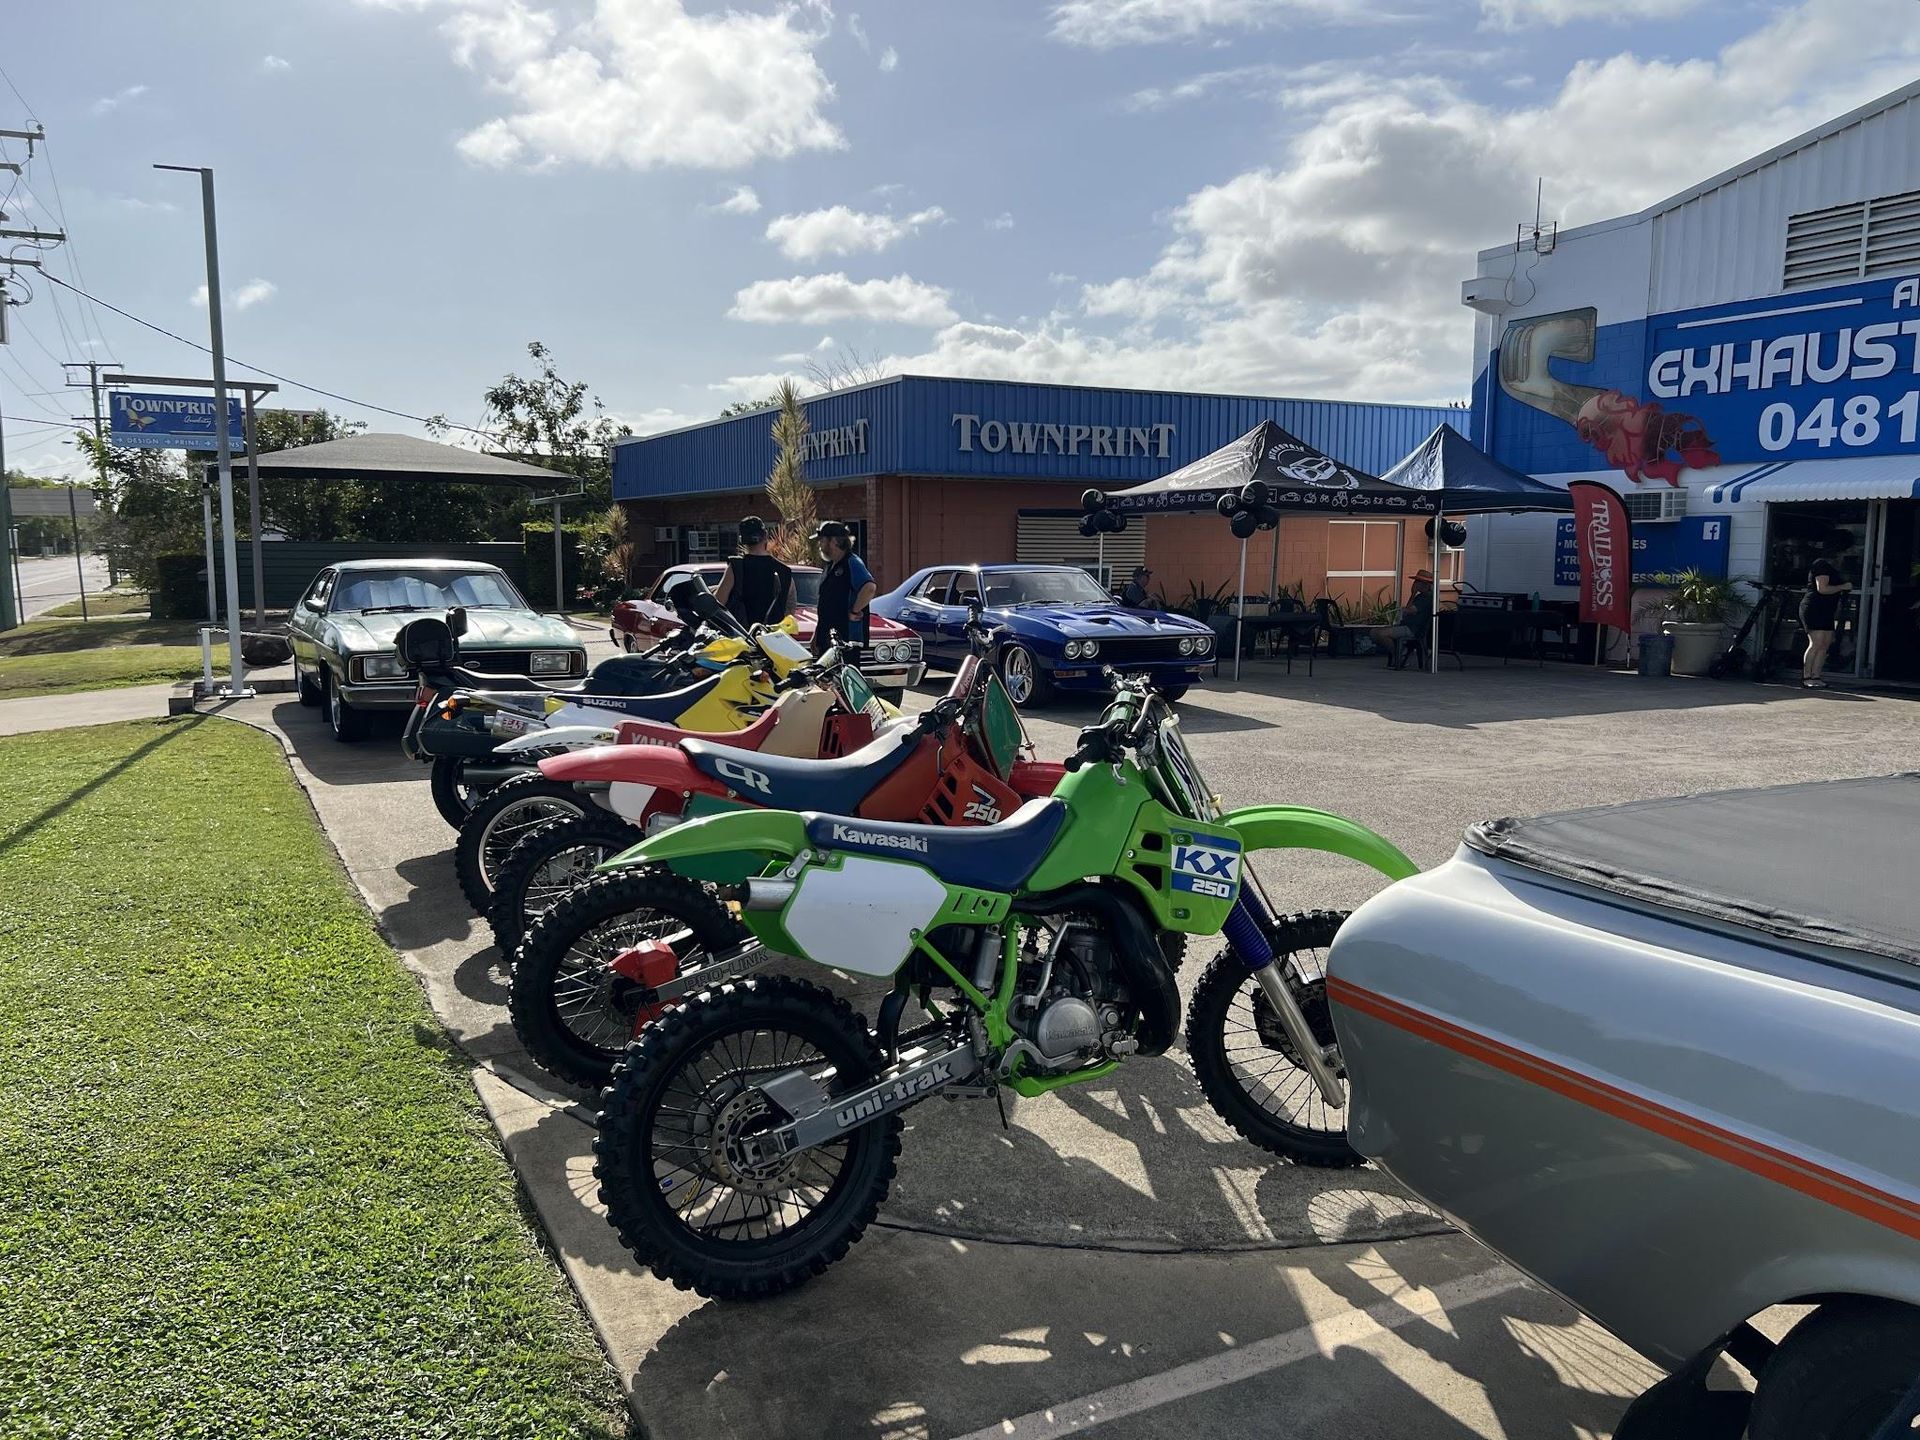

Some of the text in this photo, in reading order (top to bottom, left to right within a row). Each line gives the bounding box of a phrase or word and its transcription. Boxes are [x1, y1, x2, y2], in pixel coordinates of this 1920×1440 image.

[1893, 278, 1920, 309] A
[1649, 319, 1920, 398] EXHAUST
[952, 413, 1176, 458] TOWNPRINT
[1758, 391, 1920, 451] 0481
[127, 437, 159, 445] DESIGN
[799, 418, 869, 462] WNPRINT
[1590, 499, 1613, 606] TRAILBOSS
[583, 698, 627, 709] SUZUKI
[715, 758, 772, 795] CR
[963, 802, 1002, 824] 250
[833, 823, 928, 852] Kawasaki
[1175, 847, 1236, 880] KX
[1191, 878, 1230, 898] 250
[684, 947, 769, 992] PRO-LINK
[836, 1063, 952, 1128] uni-trak
